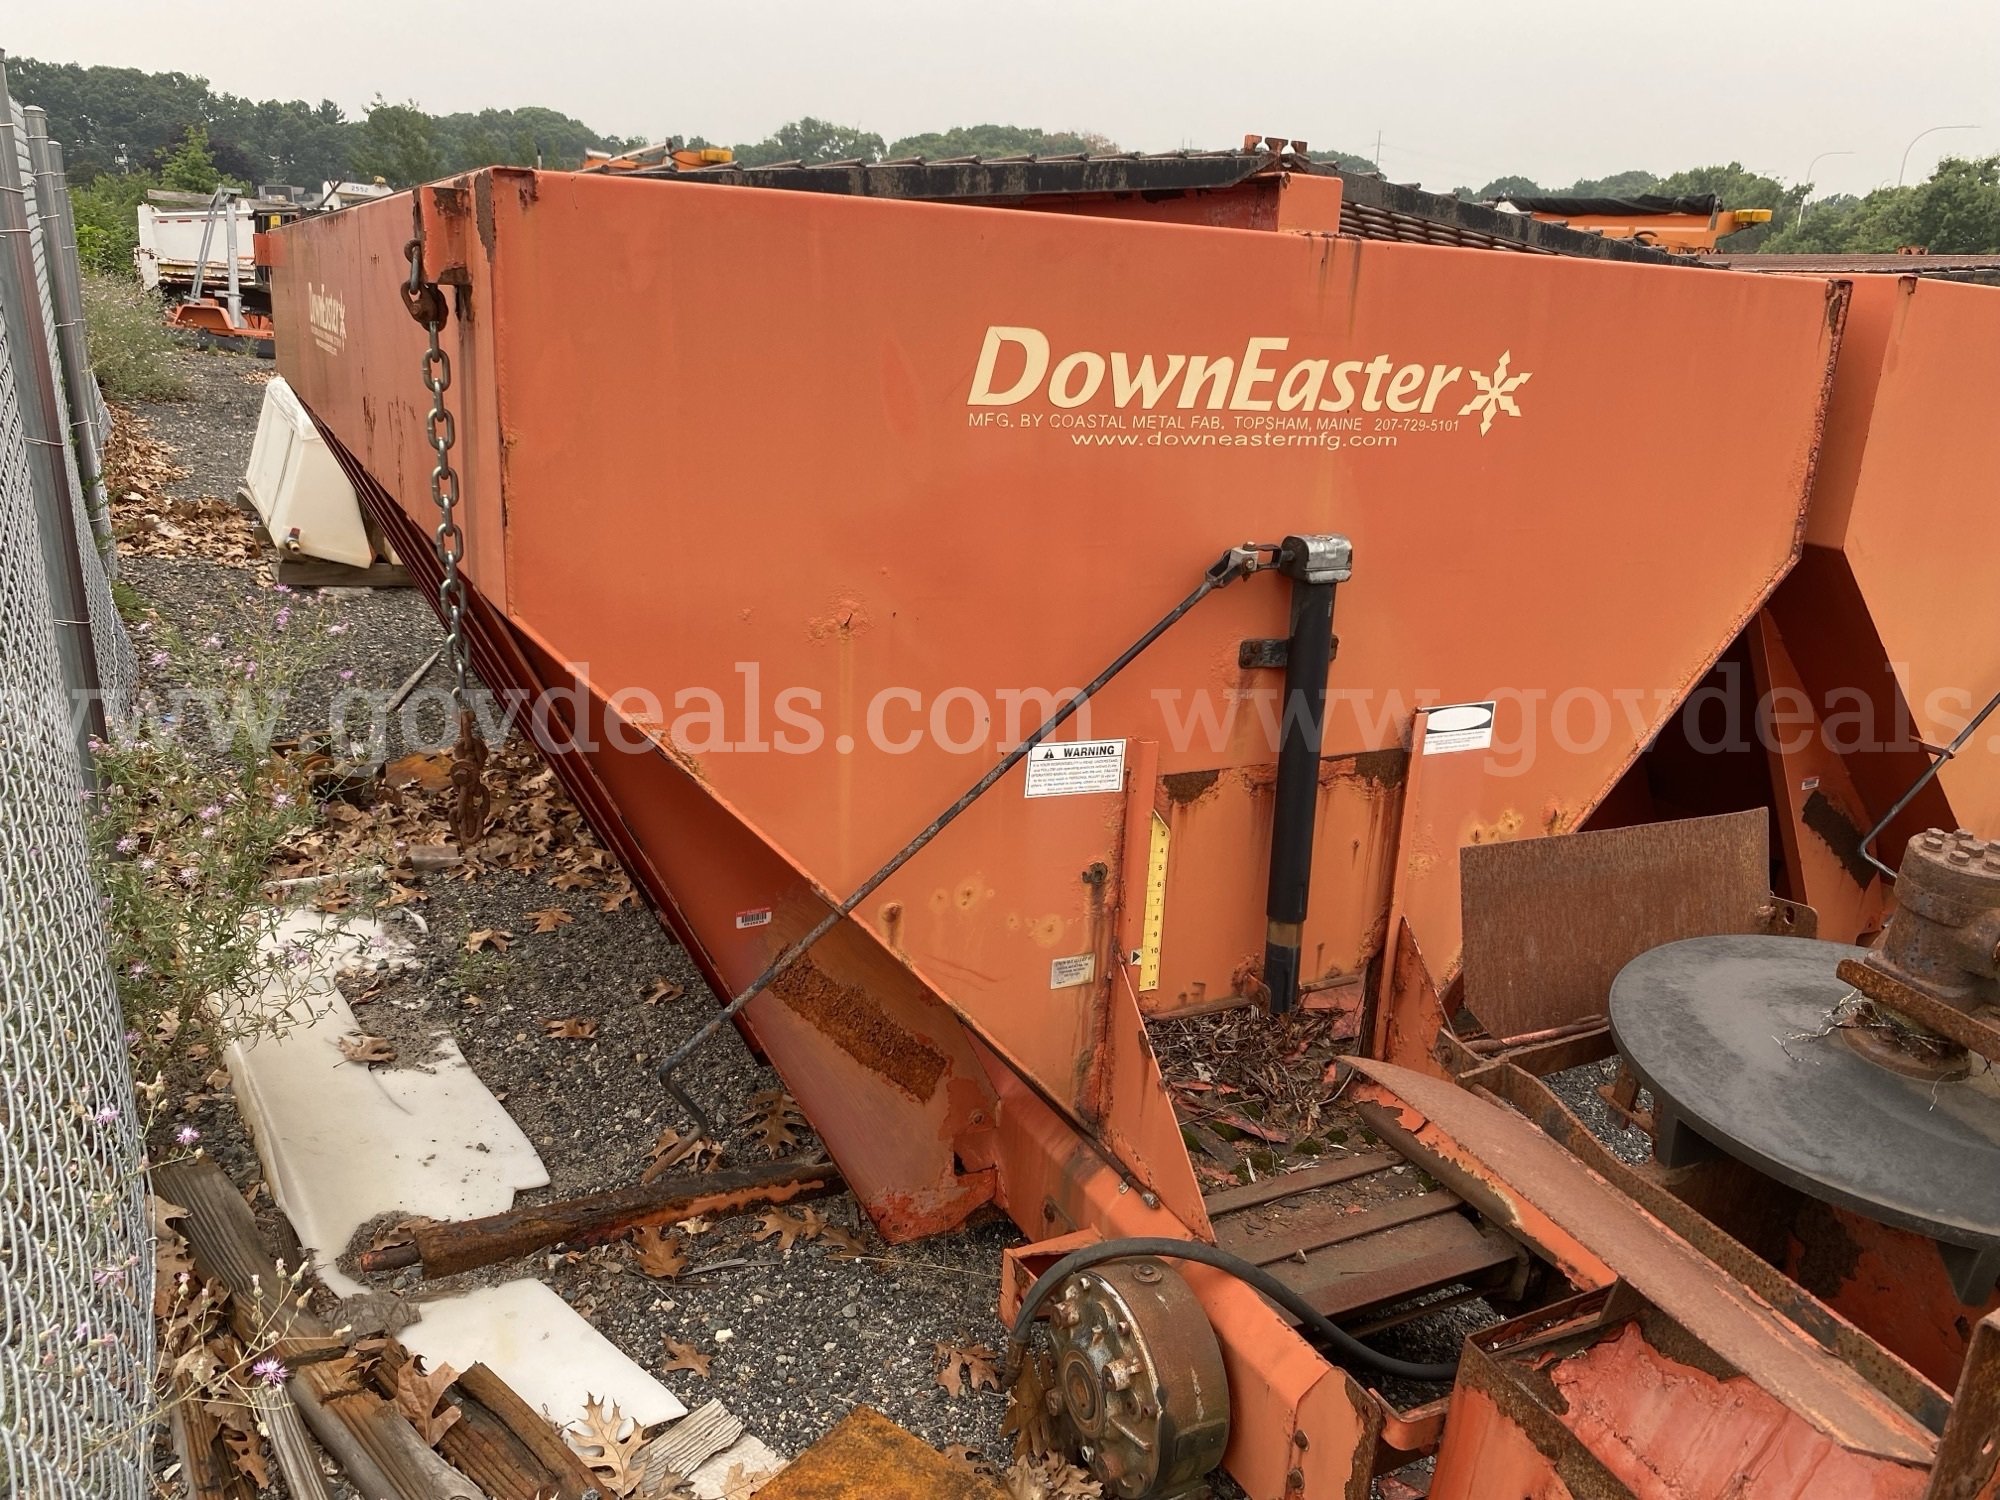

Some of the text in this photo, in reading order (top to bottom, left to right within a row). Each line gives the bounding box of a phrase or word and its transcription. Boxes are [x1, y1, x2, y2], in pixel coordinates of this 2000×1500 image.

[967, 326, 1463, 413] DownEaster
[968, 413, 1459, 433] MFG. BY COASTAL METAL FAB. TOPSHAM, MAINE 207-729-5101
[1071, 431, 1398, 450] www.downeastermfg.com
[1064, 745, 1115, 757] WARNING
